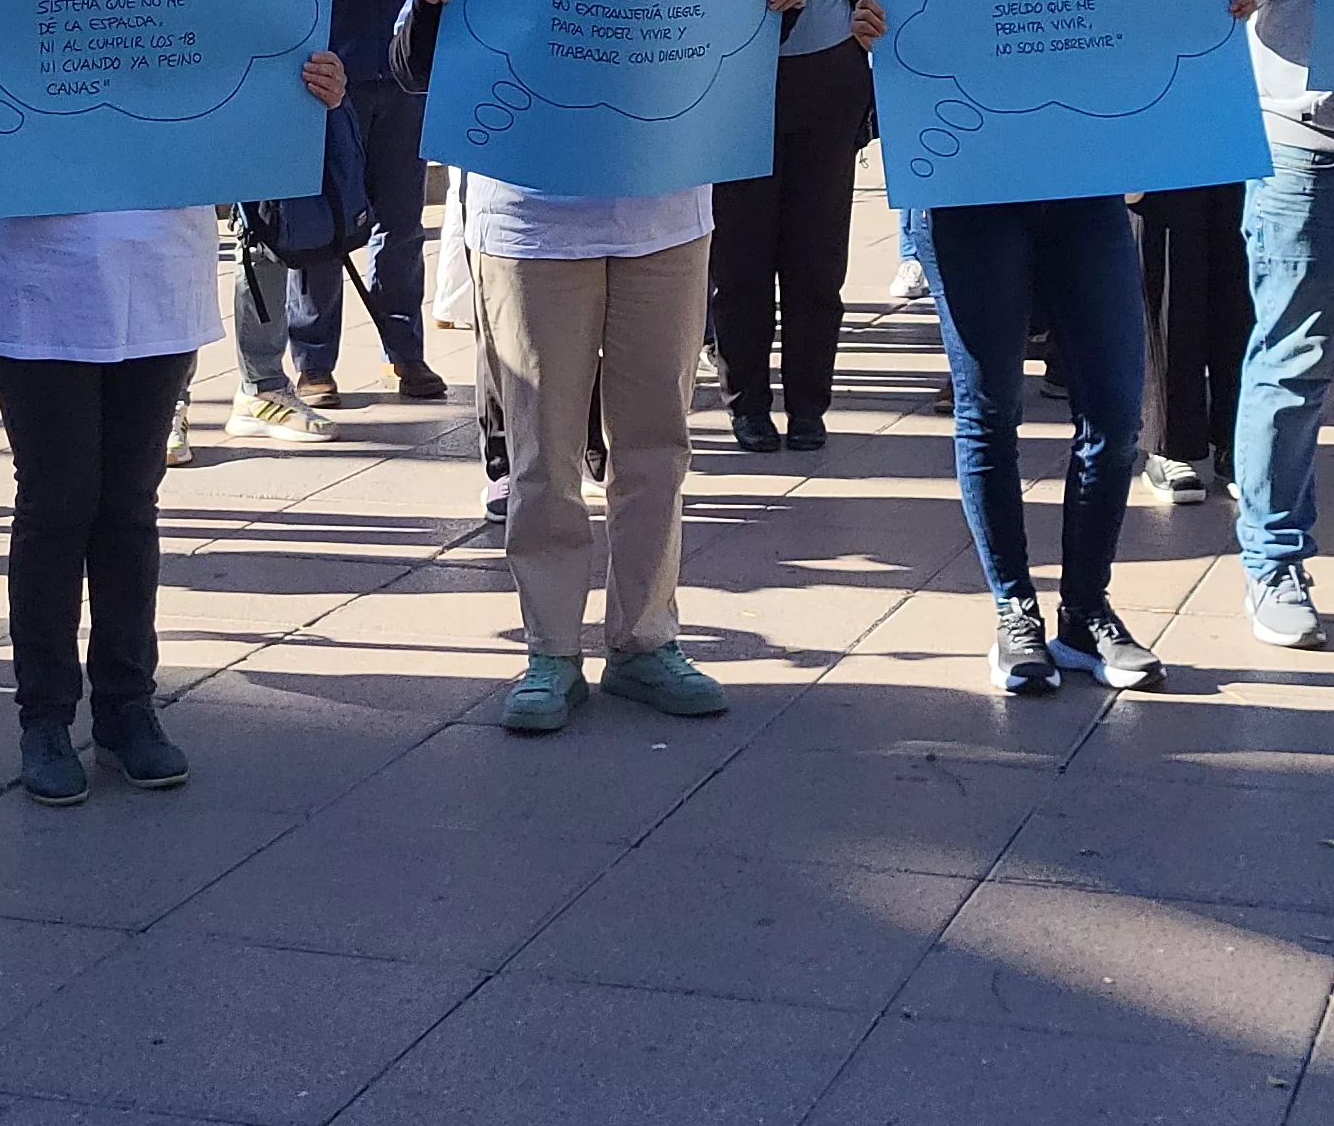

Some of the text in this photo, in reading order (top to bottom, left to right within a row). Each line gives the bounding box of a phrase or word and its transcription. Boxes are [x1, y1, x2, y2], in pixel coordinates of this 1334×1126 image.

[576, 3, 662, 20] EXTRANJERÍA
[992, 0, 1095, 17] SUELDO QUE ME
[39, 15, 162, 35] DÉ LA ESPALDA,
[551, 18, 686, 40] PARA PODER VIVIR Y
[995, 22, 1045, 36] PERMITA
[40, 32, 195, 55] NI AL CUMPLIR LOS 18
[547, 42, 620, 64] TRABAJAR
[628, 53, 653, 64] CON
[996, 43, 1012, 56] NO
[1017, 41, 1045, 54] SOLO
[40, 53, 202, 74] NI CUANDO YA PEINO
